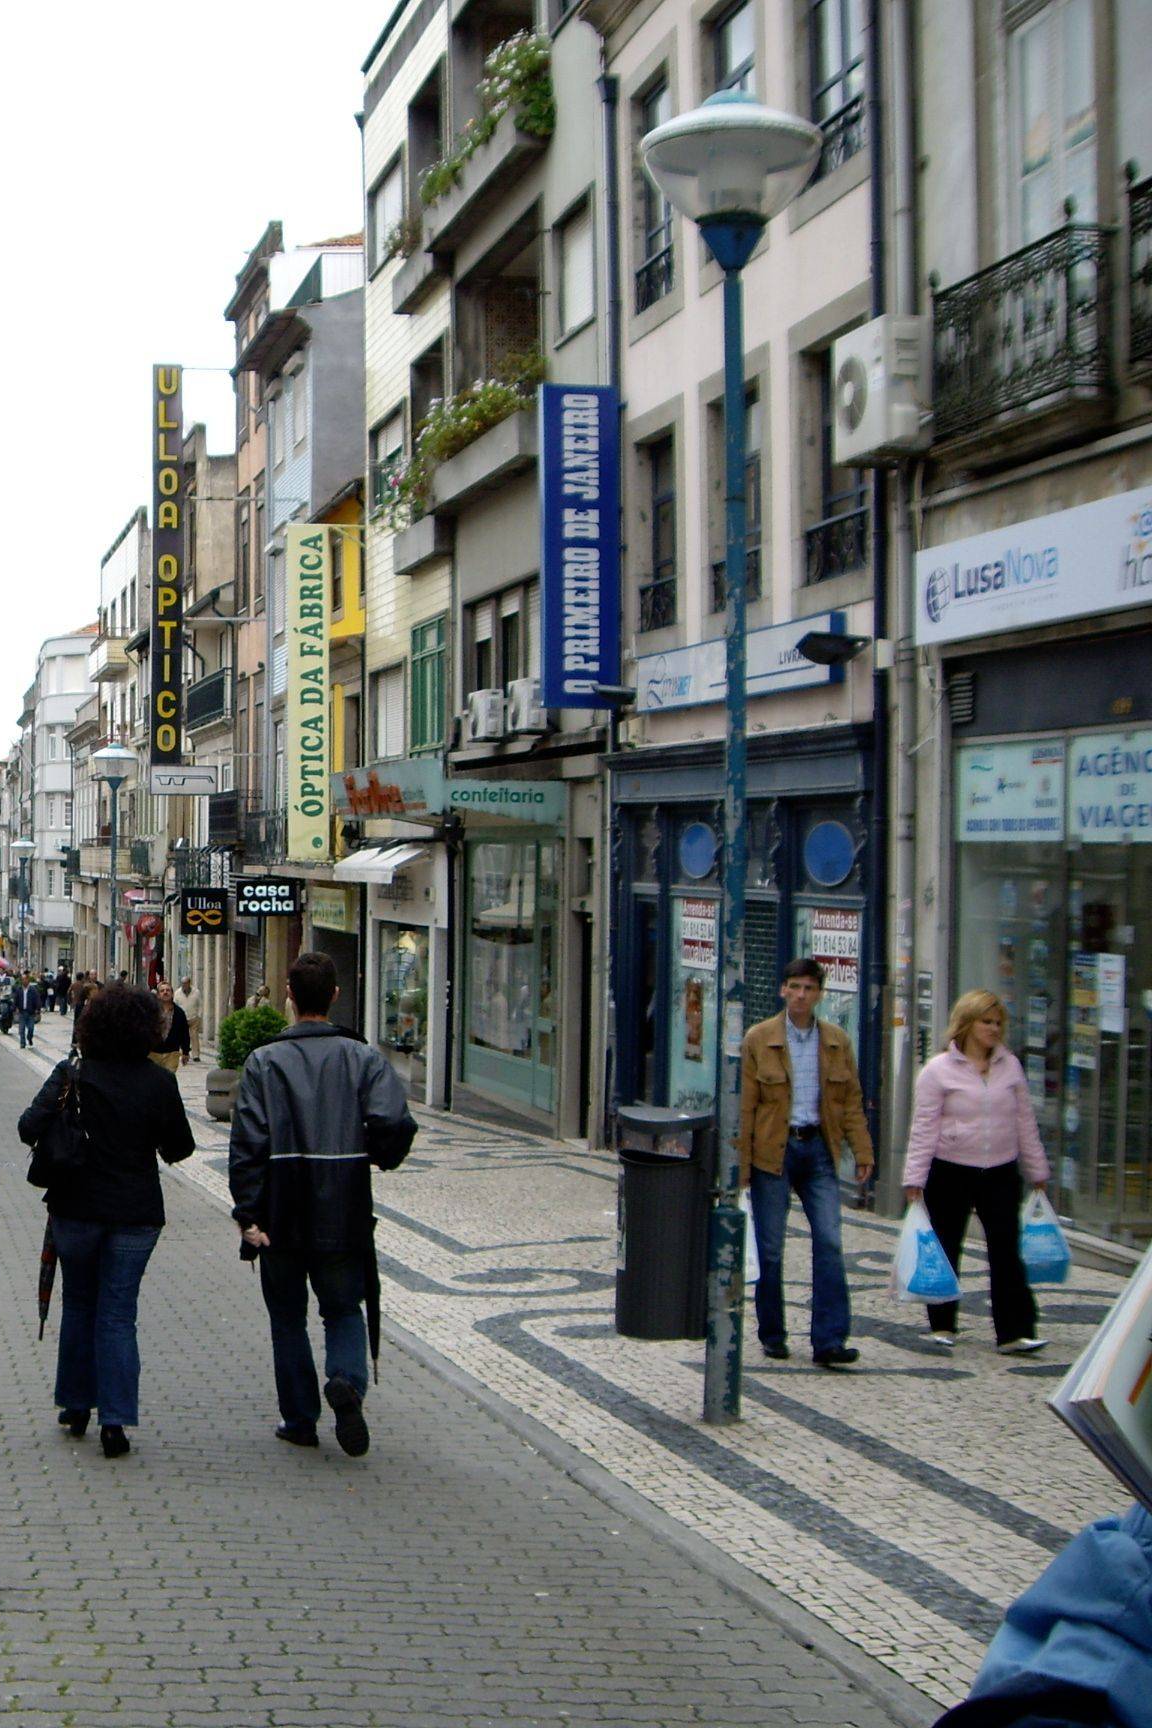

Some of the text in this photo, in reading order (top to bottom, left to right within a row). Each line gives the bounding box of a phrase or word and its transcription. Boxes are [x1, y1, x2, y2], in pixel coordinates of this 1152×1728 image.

[562, 393, 600, 694] O PRIMEIRO DE JANEIRO
[156, 367, 179, 752] ULLOA OPTICO
[953, 545, 1060, 599] LusaNova
[293, 532, 325, 818] ÓPTICA DA FÁBRICA
[450, 787, 545, 803] confeitaria
[243, 884, 290, 897] casa
[186, 896, 222, 910] Ulloa
[238, 896, 294, 912] rocha
[813, 909, 859, 930] Arrenda-se
